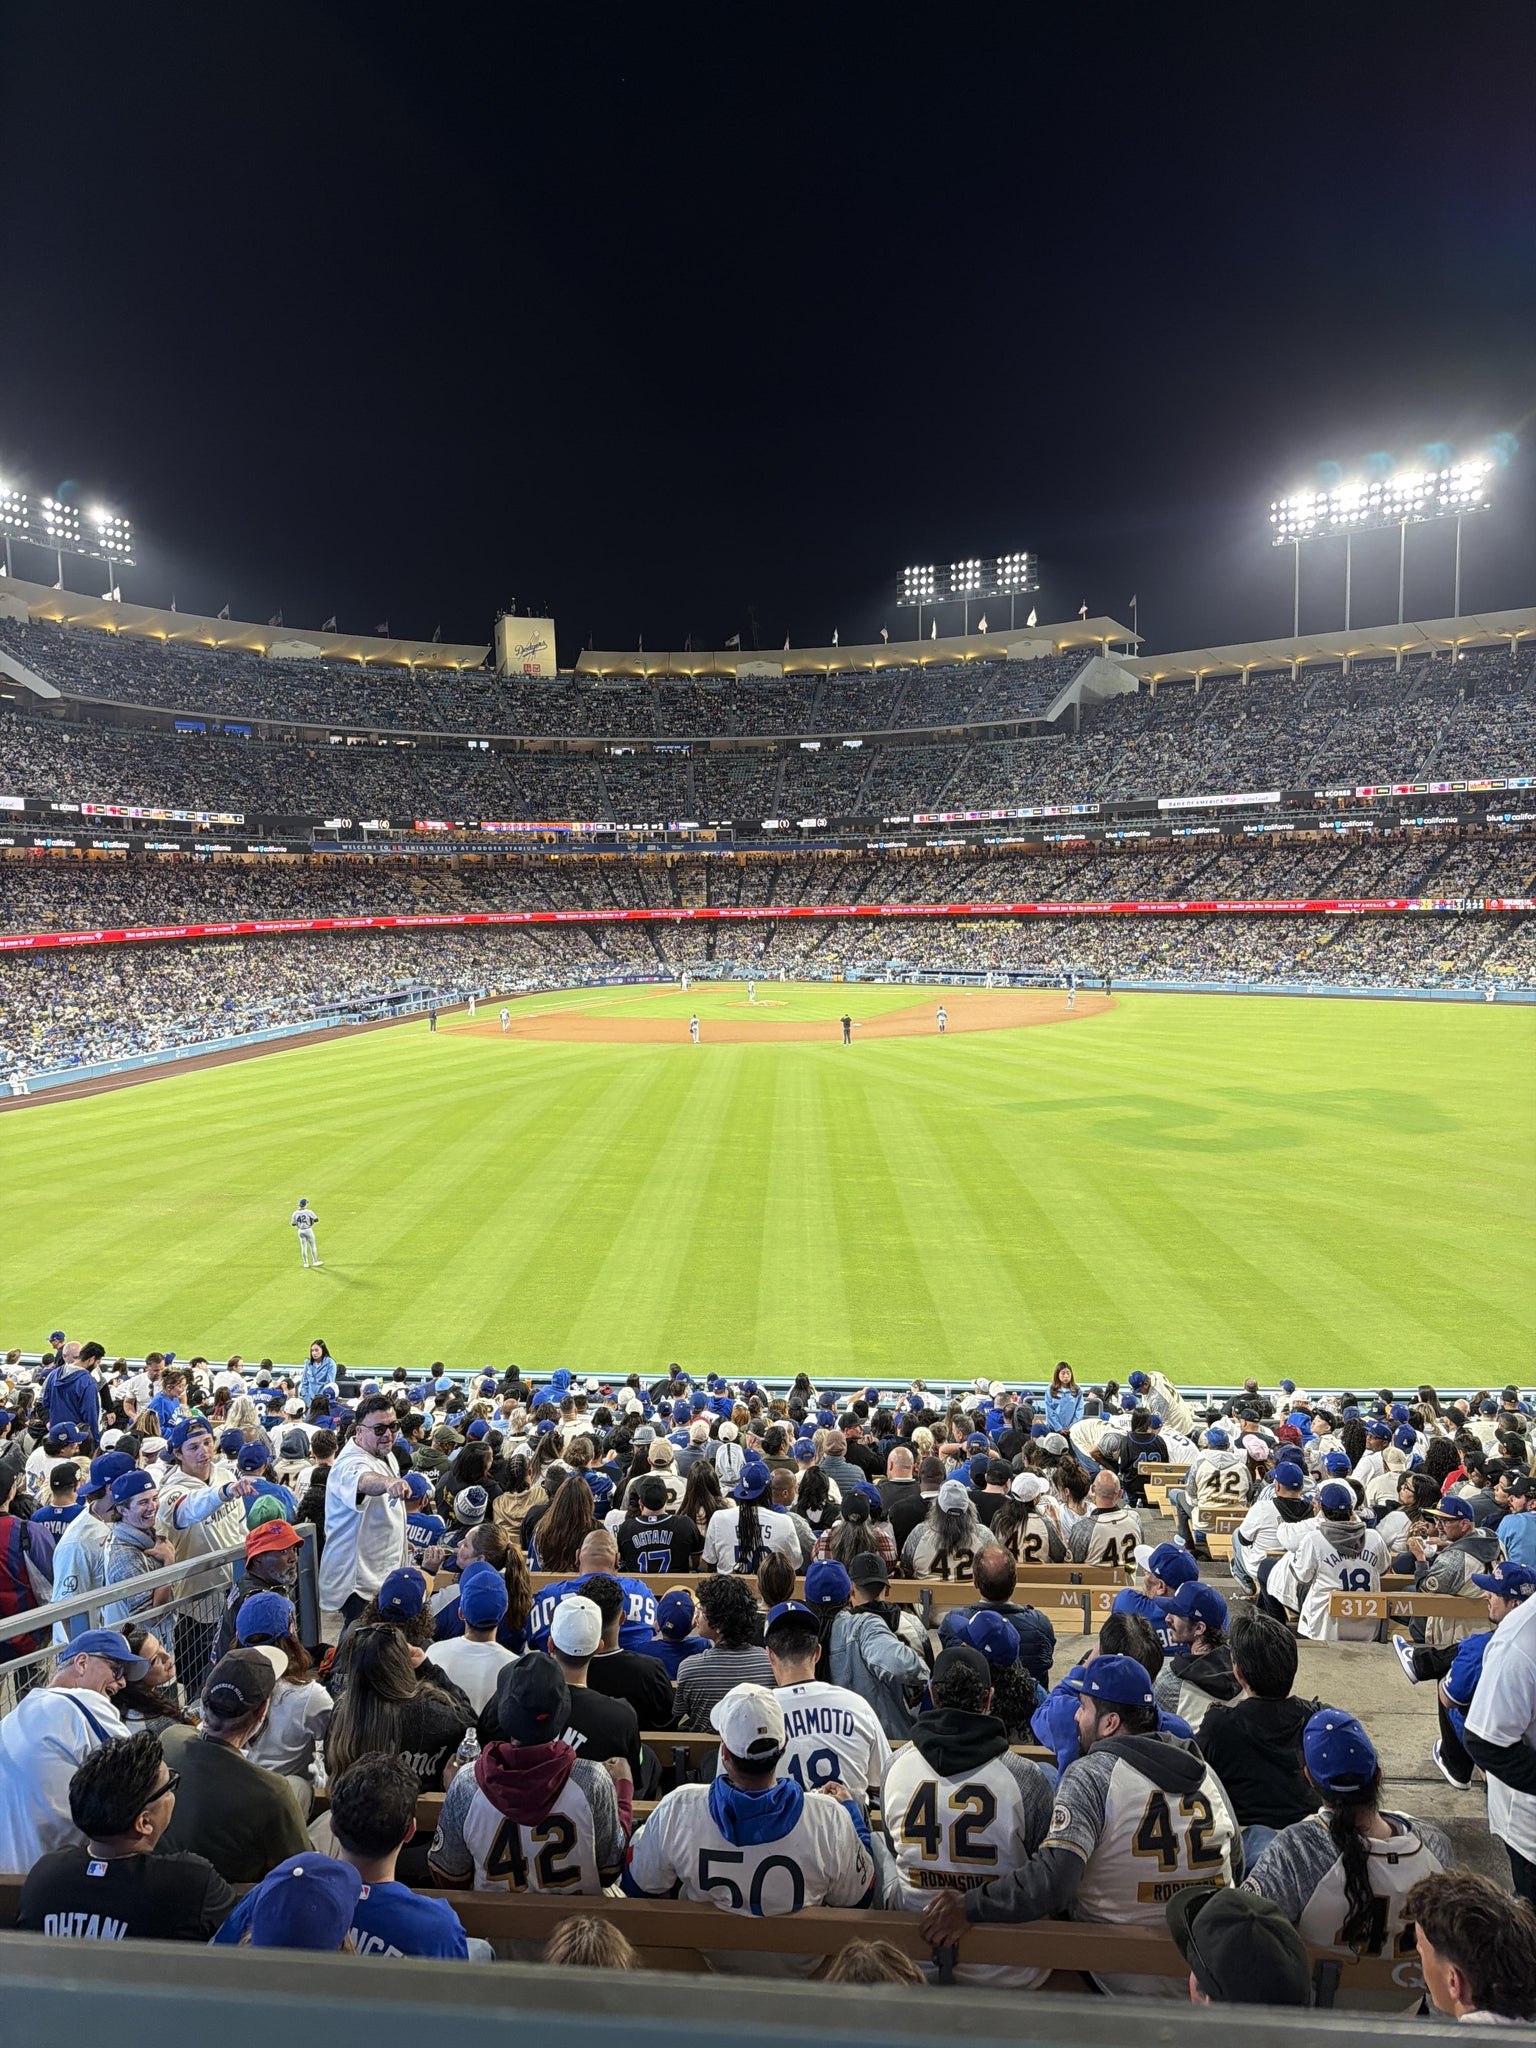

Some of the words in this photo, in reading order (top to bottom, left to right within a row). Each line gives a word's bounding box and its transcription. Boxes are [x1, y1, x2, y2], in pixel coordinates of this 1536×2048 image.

[1319, 821, 1334, 829] blue
[1423, 816, 1458, 824] california
[1486, 814, 1503, 822] blue
[1191, 827, 1220, 835] california
[1263, 823, 1295, 831] california
[1105, 831, 1118, 839] blue
[342, 842, 376, 850] WELCOME
[296, 1214, 307, 1224] 42
[1154, 1476, 1163, 1486] D
[1206, 1469, 1241, 1495] 42
[1200, 1511, 1212, 1521] G
[1219, 1521, 1232, 1531] H
[632, 1529, 674, 1549] OHTANI
[1101, 1532, 1138, 1568] 42
[637, 1548, 672, 1573] 17
[929, 1549, 975, 1583] 42
[1112, 1570, 1121, 1584] L
[1338, 1567, 1372, 1592] 18
[1060, 1591, 1079, 1606] M
[1340, 1598, 1378, 1617] 312
[1394, 1600, 1414, 1615] M
[901, 1779, 998, 1867] 42
[1132, 1789, 1225, 1873] 42
[483, 1811, 582, 1894] 42
[698, 1847, 805, 1917] 50
[44, 1911, 129, 1941] OHTANI
